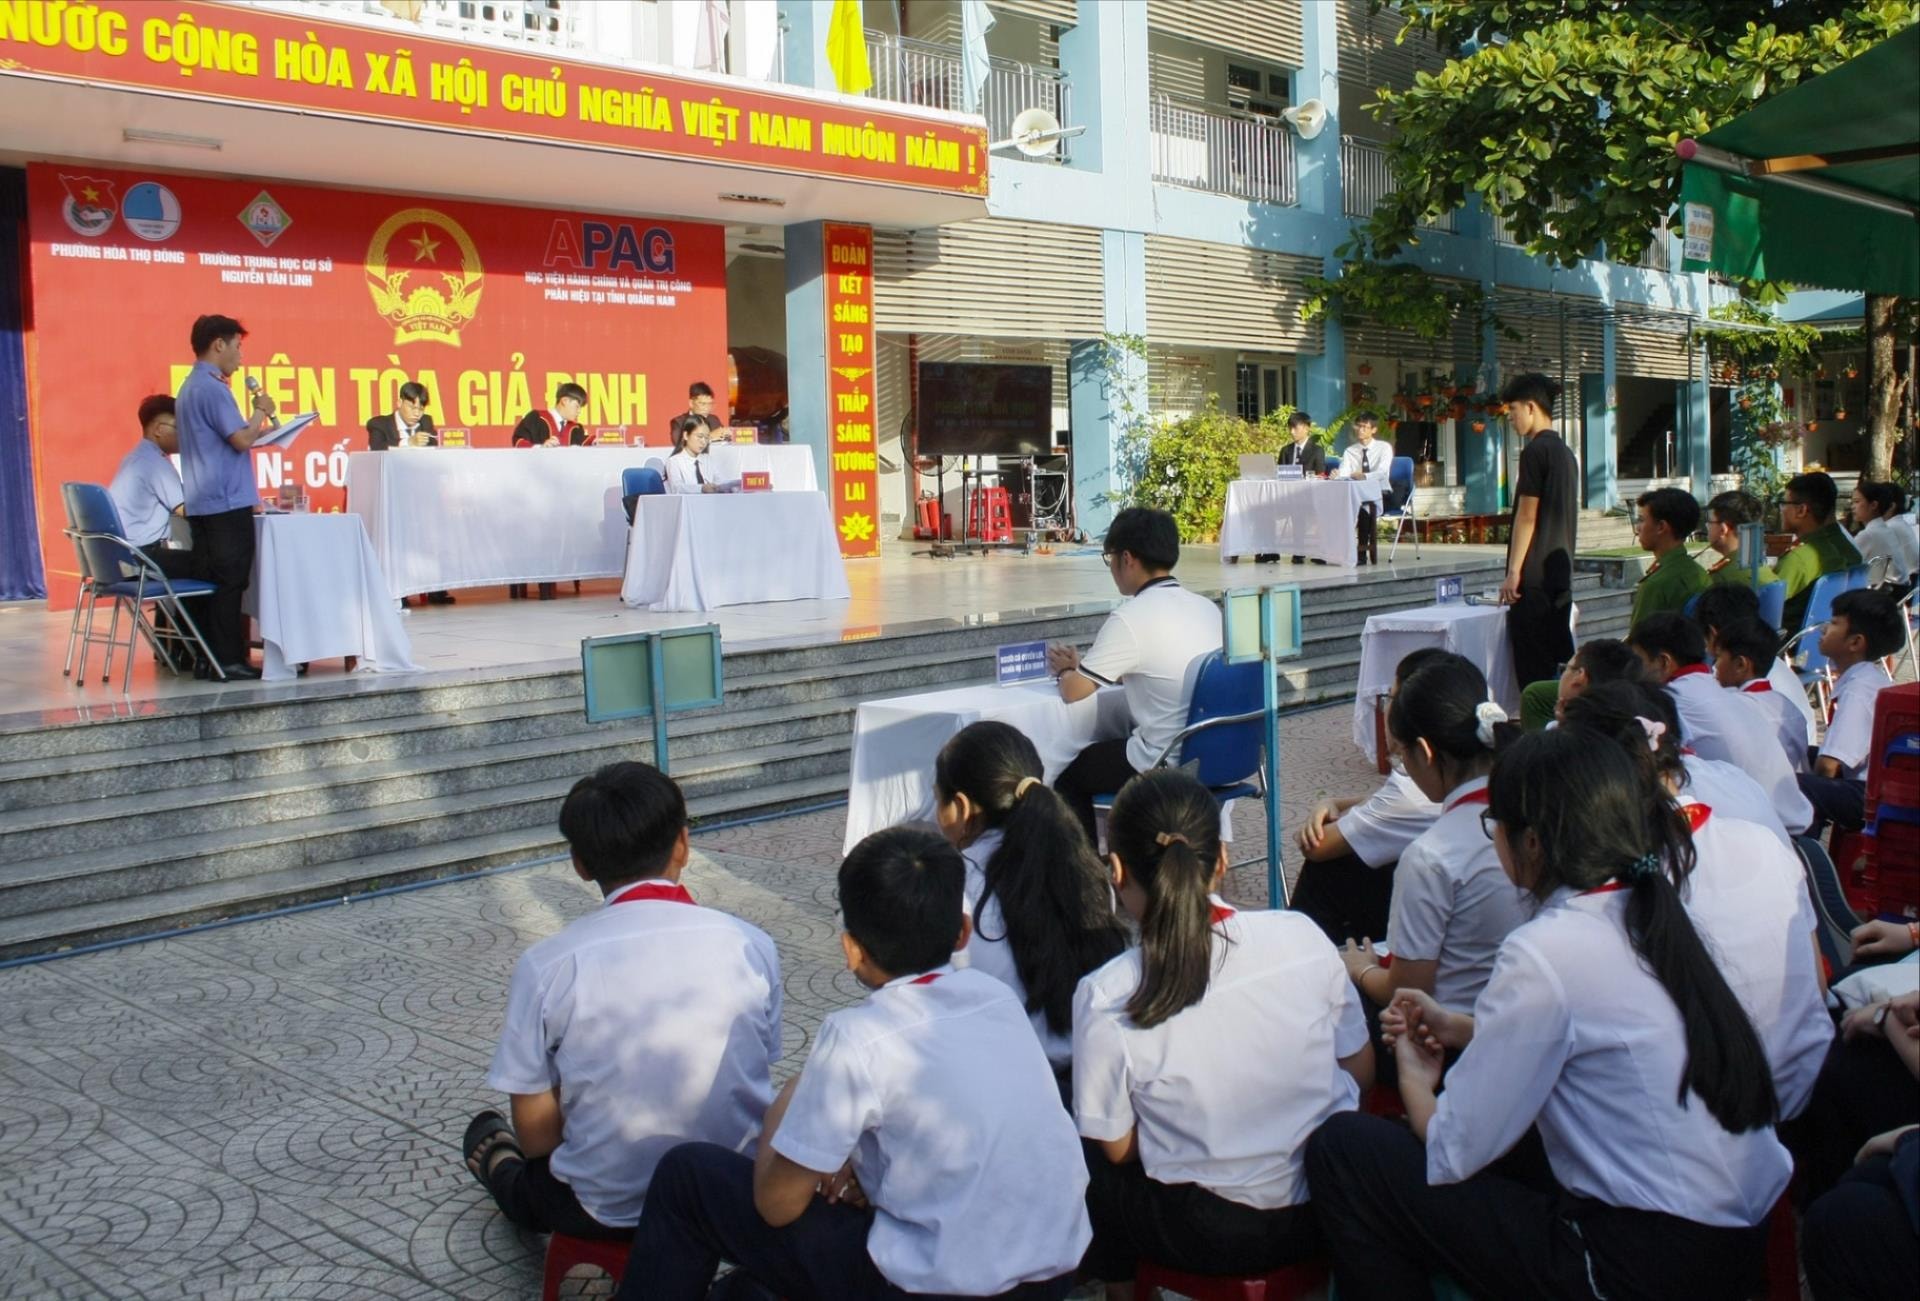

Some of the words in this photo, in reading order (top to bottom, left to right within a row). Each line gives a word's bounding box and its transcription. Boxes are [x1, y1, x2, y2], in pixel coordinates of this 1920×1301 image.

[142, 12, 259, 77] CỘNG
[274, 31, 354, 89] HÒA
[364, 48, 418, 98] XÃ
[429, 58, 489, 115] HỘI
[501, 66, 568, 118] CHỦ
[578, 86, 674, 133] NGHĨA
[681, 98, 740, 148] VIỆT
[749, 112, 812, 152] NAM
[821, 122, 896, 164] MUÔN
[904, 130, 961, 174] NĂM
[103, 244, 128, 260] HÒA
[129, 247, 152, 264] THỌ
[543, 218, 677, 275] APAG
[831, 242, 867, 265] ĐOÀN
[243, 255, 278, 269] TRUNG
[279, 257, 301, 273] HỌC
[288, 273, 313, 287] LINH
[839, 270, 863, 295] KẾT
[833, 300, 869, 324] SÁNG
[839, 333, 863, 356] TẠO
[457, 352, 533, 427] GIẢ
[836, 419, 872, 443] SÁNG
[256, 452, 294, 489] N:
[833, 451, 876, 471] TƯƠNG
[844, 482, 866, 502] LAI
